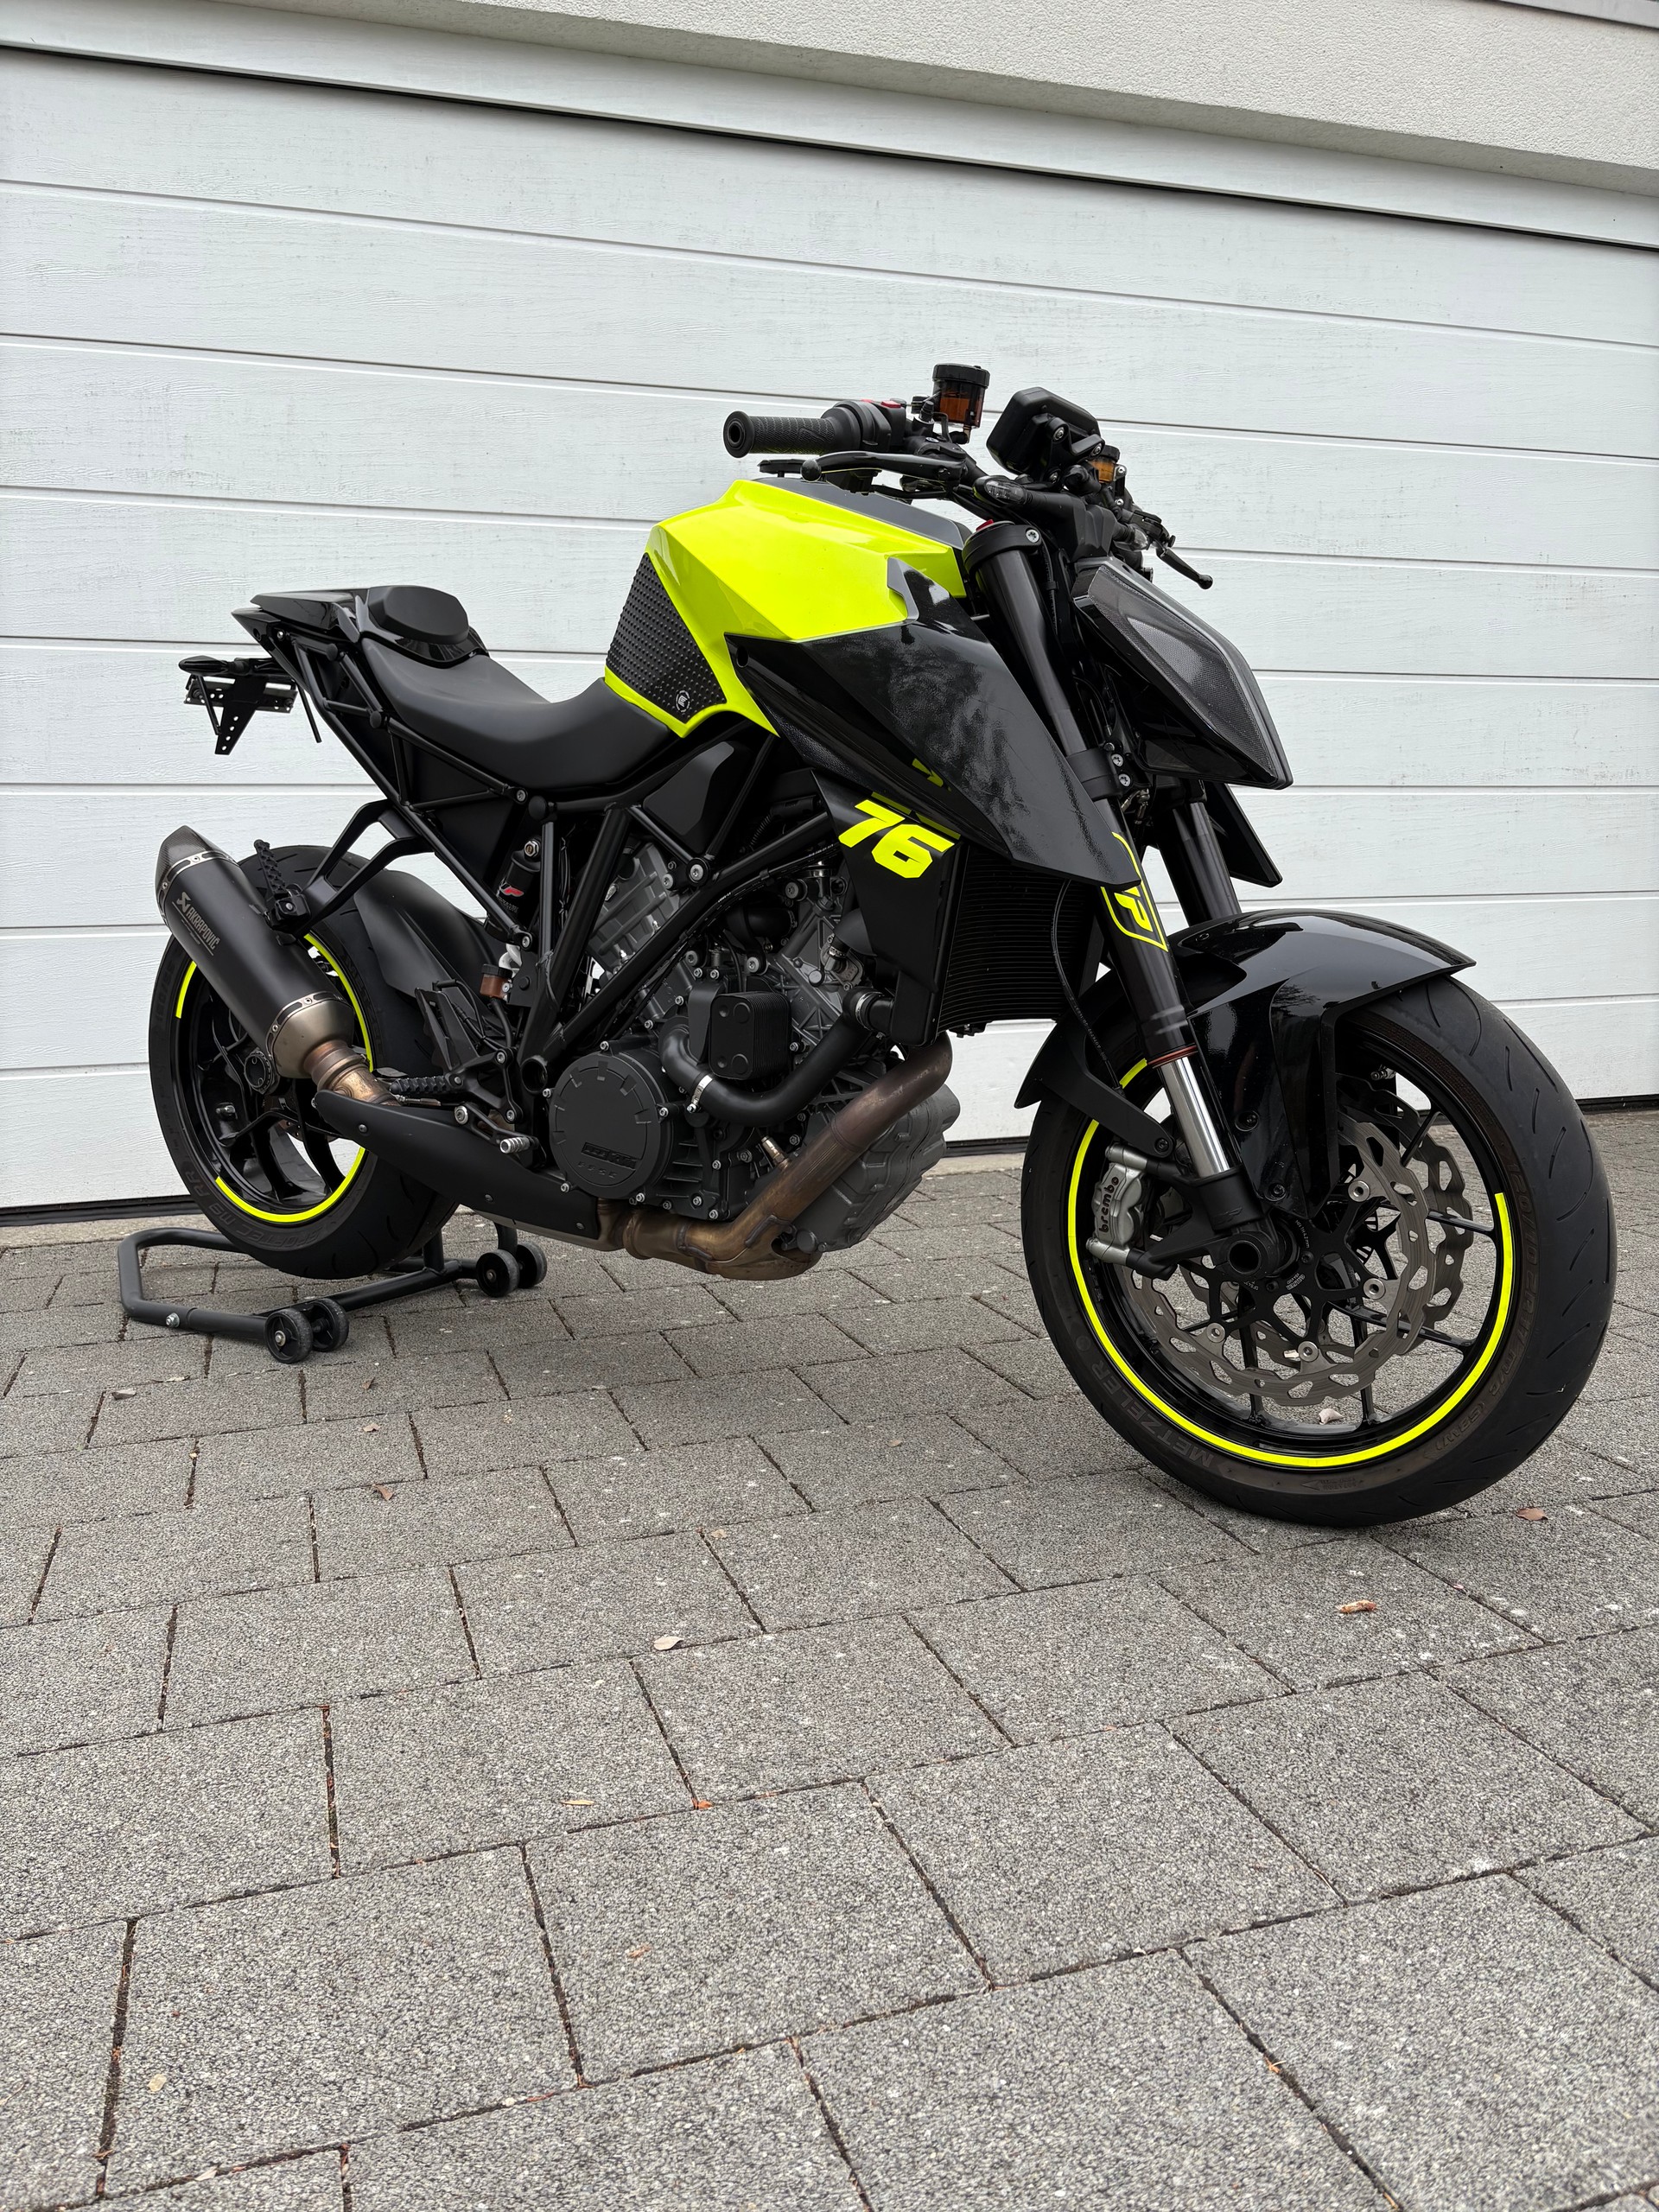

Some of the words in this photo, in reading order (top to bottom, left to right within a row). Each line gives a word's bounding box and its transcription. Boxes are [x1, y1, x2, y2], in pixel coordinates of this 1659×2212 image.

[838, 799, 955, 879] 76
[188, 906, 220, 950] AKRAPOVIČ
[185, 1171, 211, 1198] RR
[1097, 1176, 1119, 1233] brembo
[1090, 1359, 1214, 1467] METZELER
